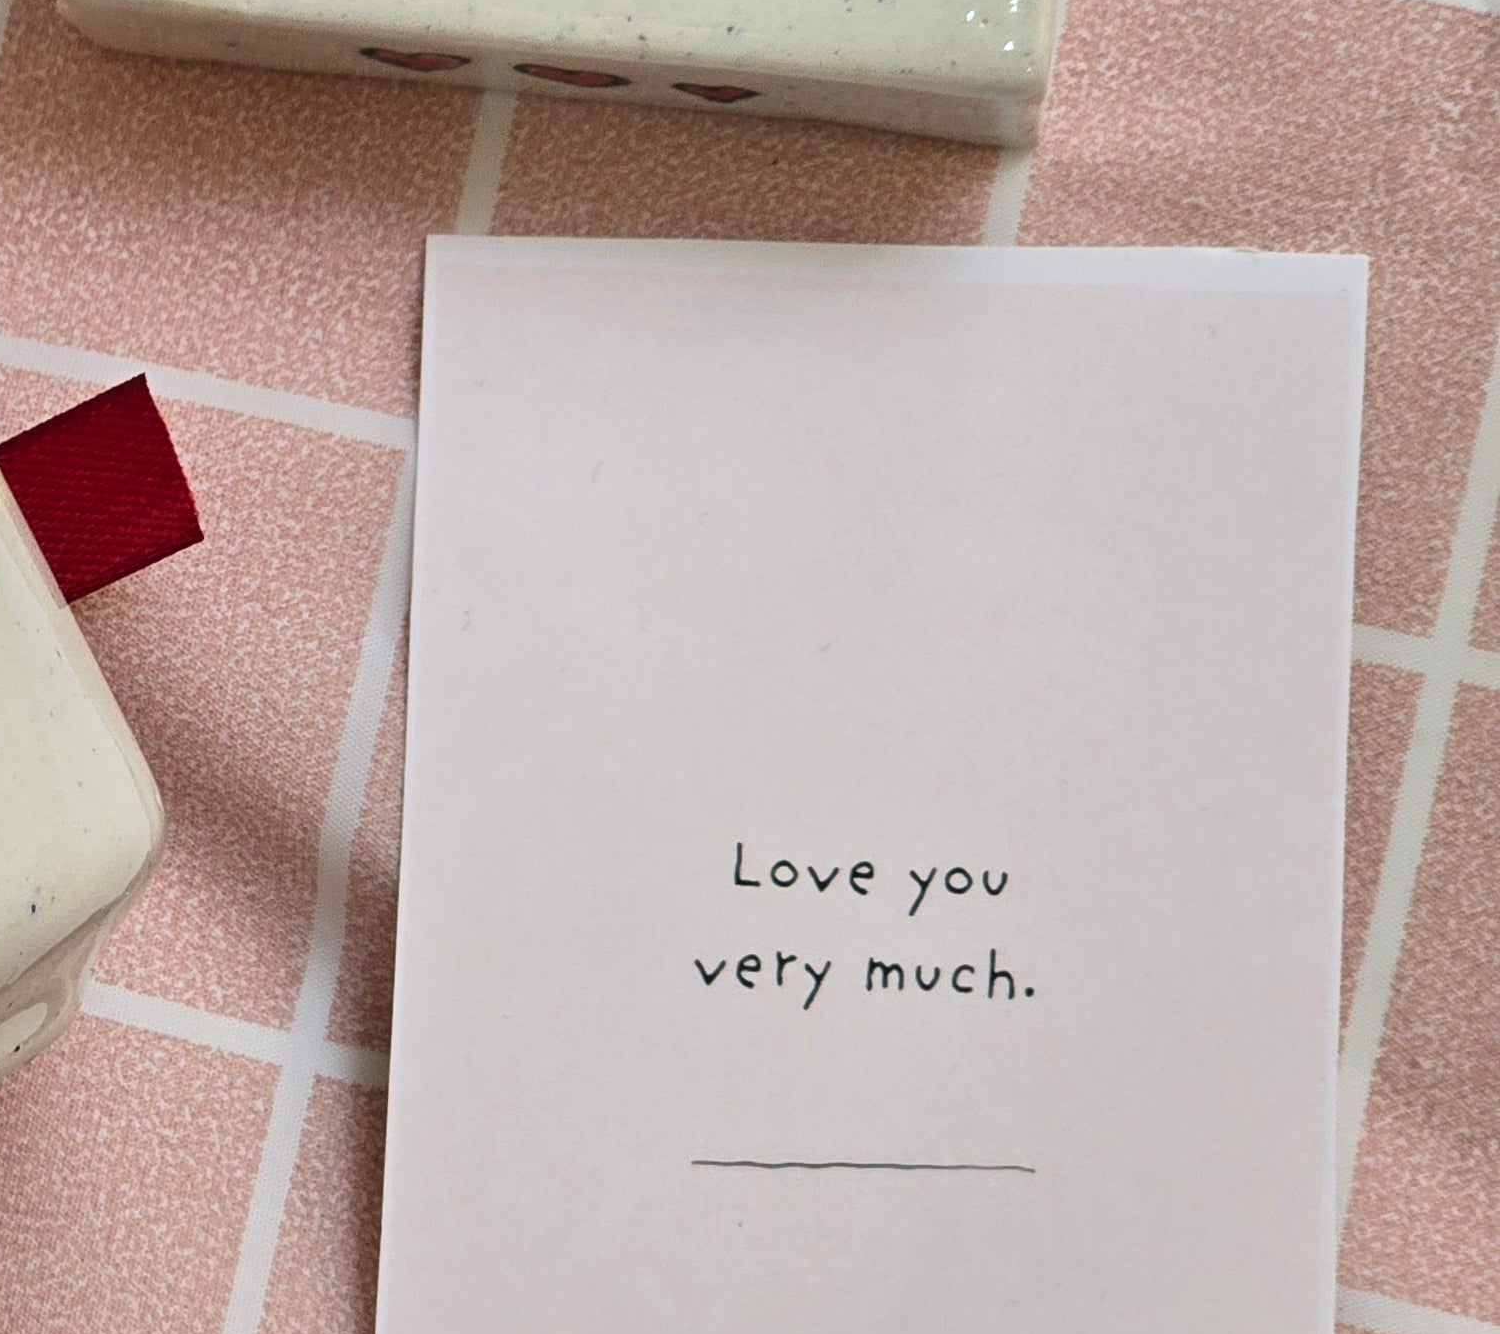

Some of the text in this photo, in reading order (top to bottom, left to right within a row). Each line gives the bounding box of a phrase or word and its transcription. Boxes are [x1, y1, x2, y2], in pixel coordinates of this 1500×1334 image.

[733, 842, 1009, 917] Love you
[693, 948, 1035, 1011] very much.
